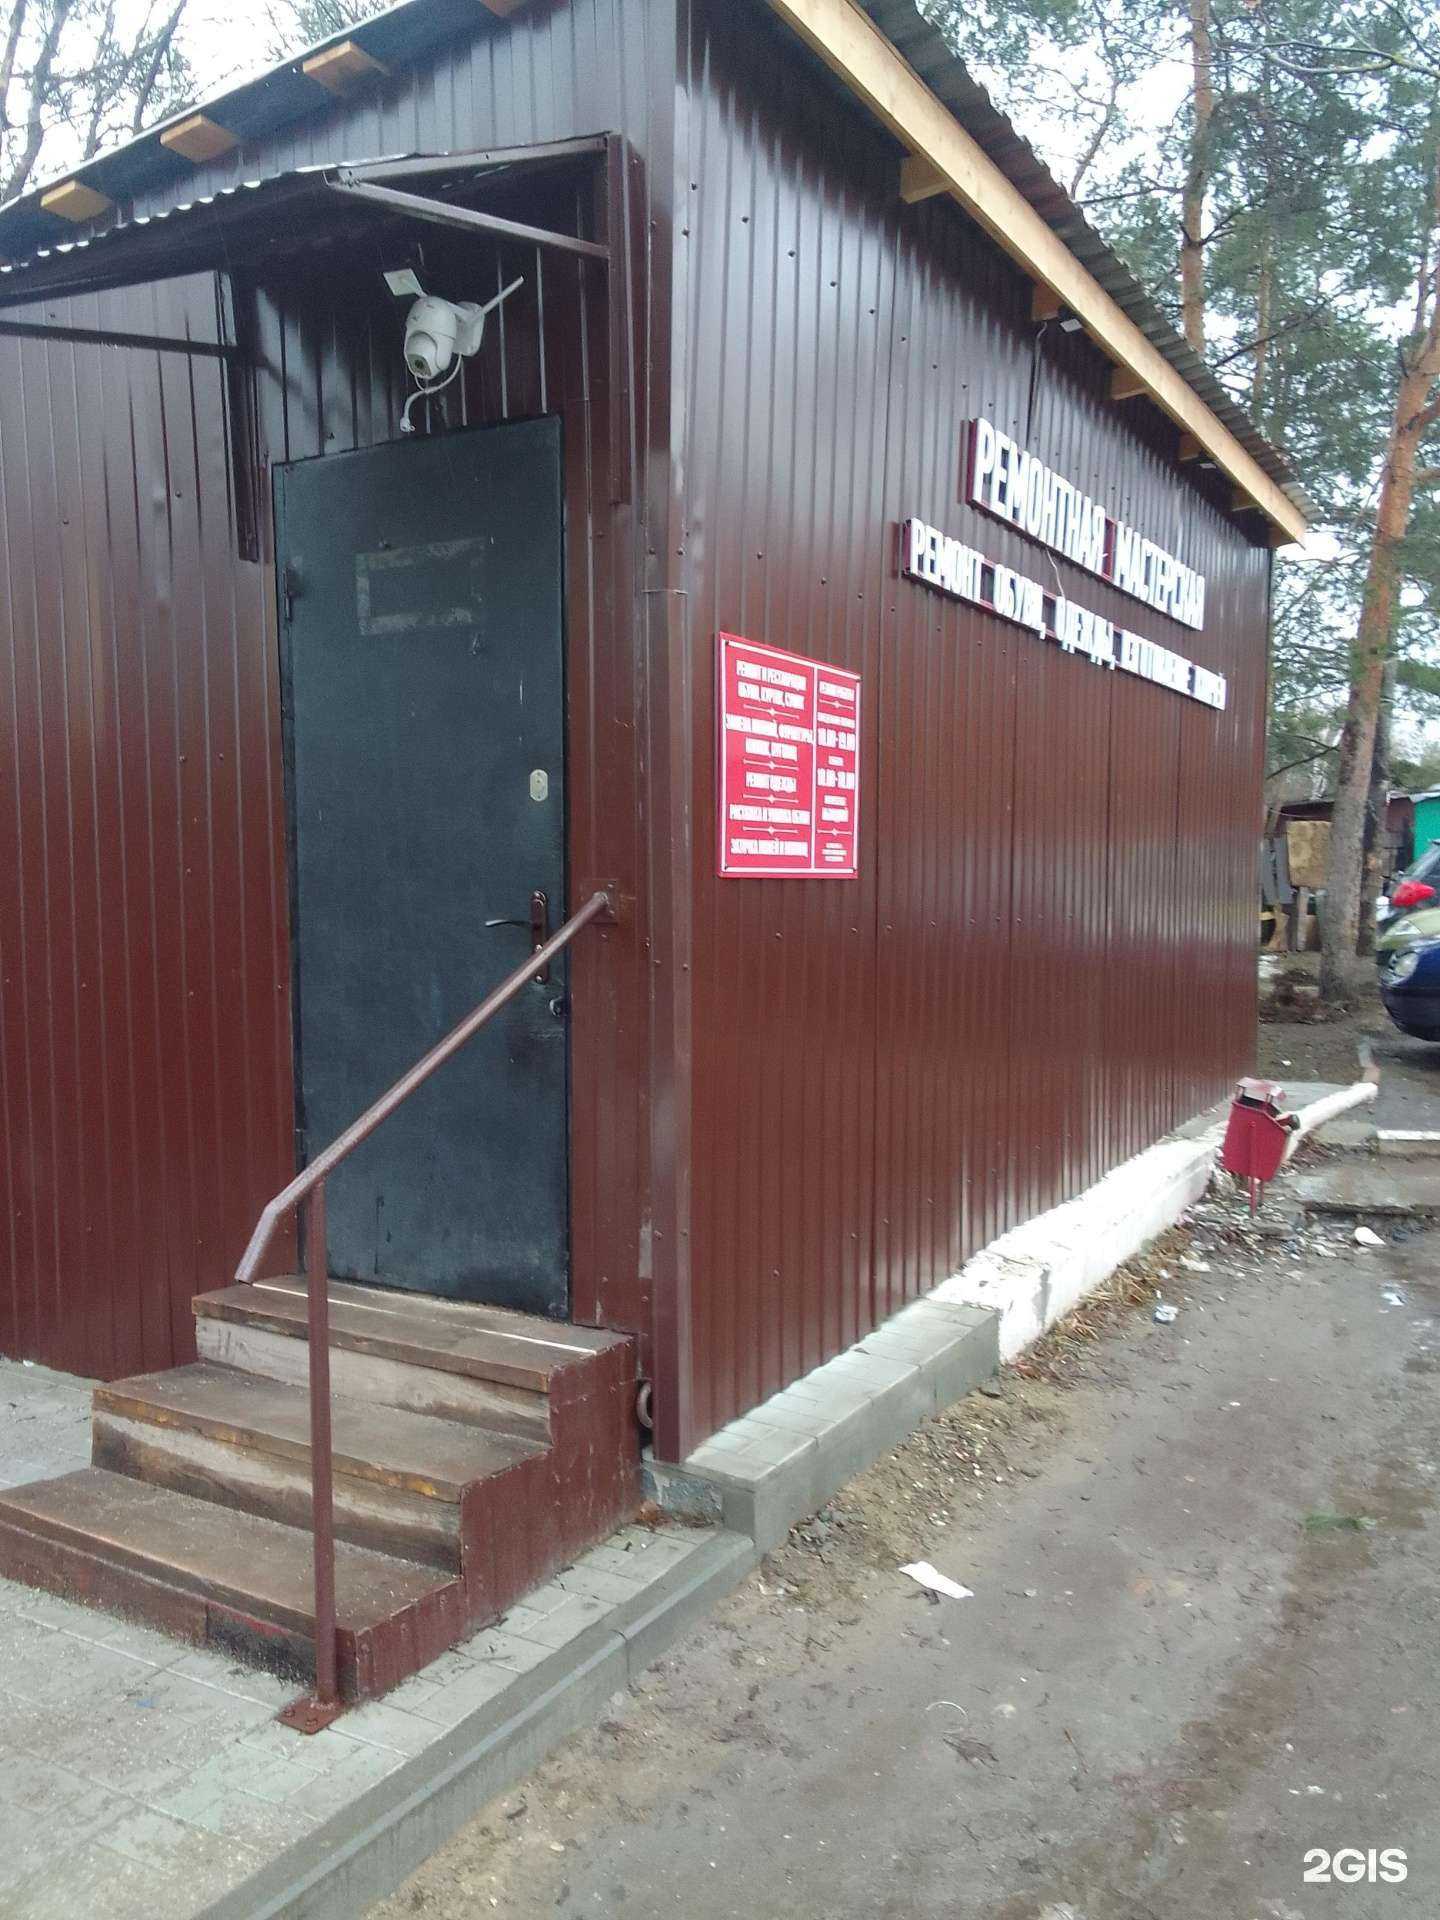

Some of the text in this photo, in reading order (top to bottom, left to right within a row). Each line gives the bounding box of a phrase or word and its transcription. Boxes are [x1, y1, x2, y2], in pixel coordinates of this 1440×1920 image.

[910, 517, 985, 604] РЕМОНТ
[972, 417, 1205, 631] РЕМОНТНАЯ МАСТЕРСКАЯ
